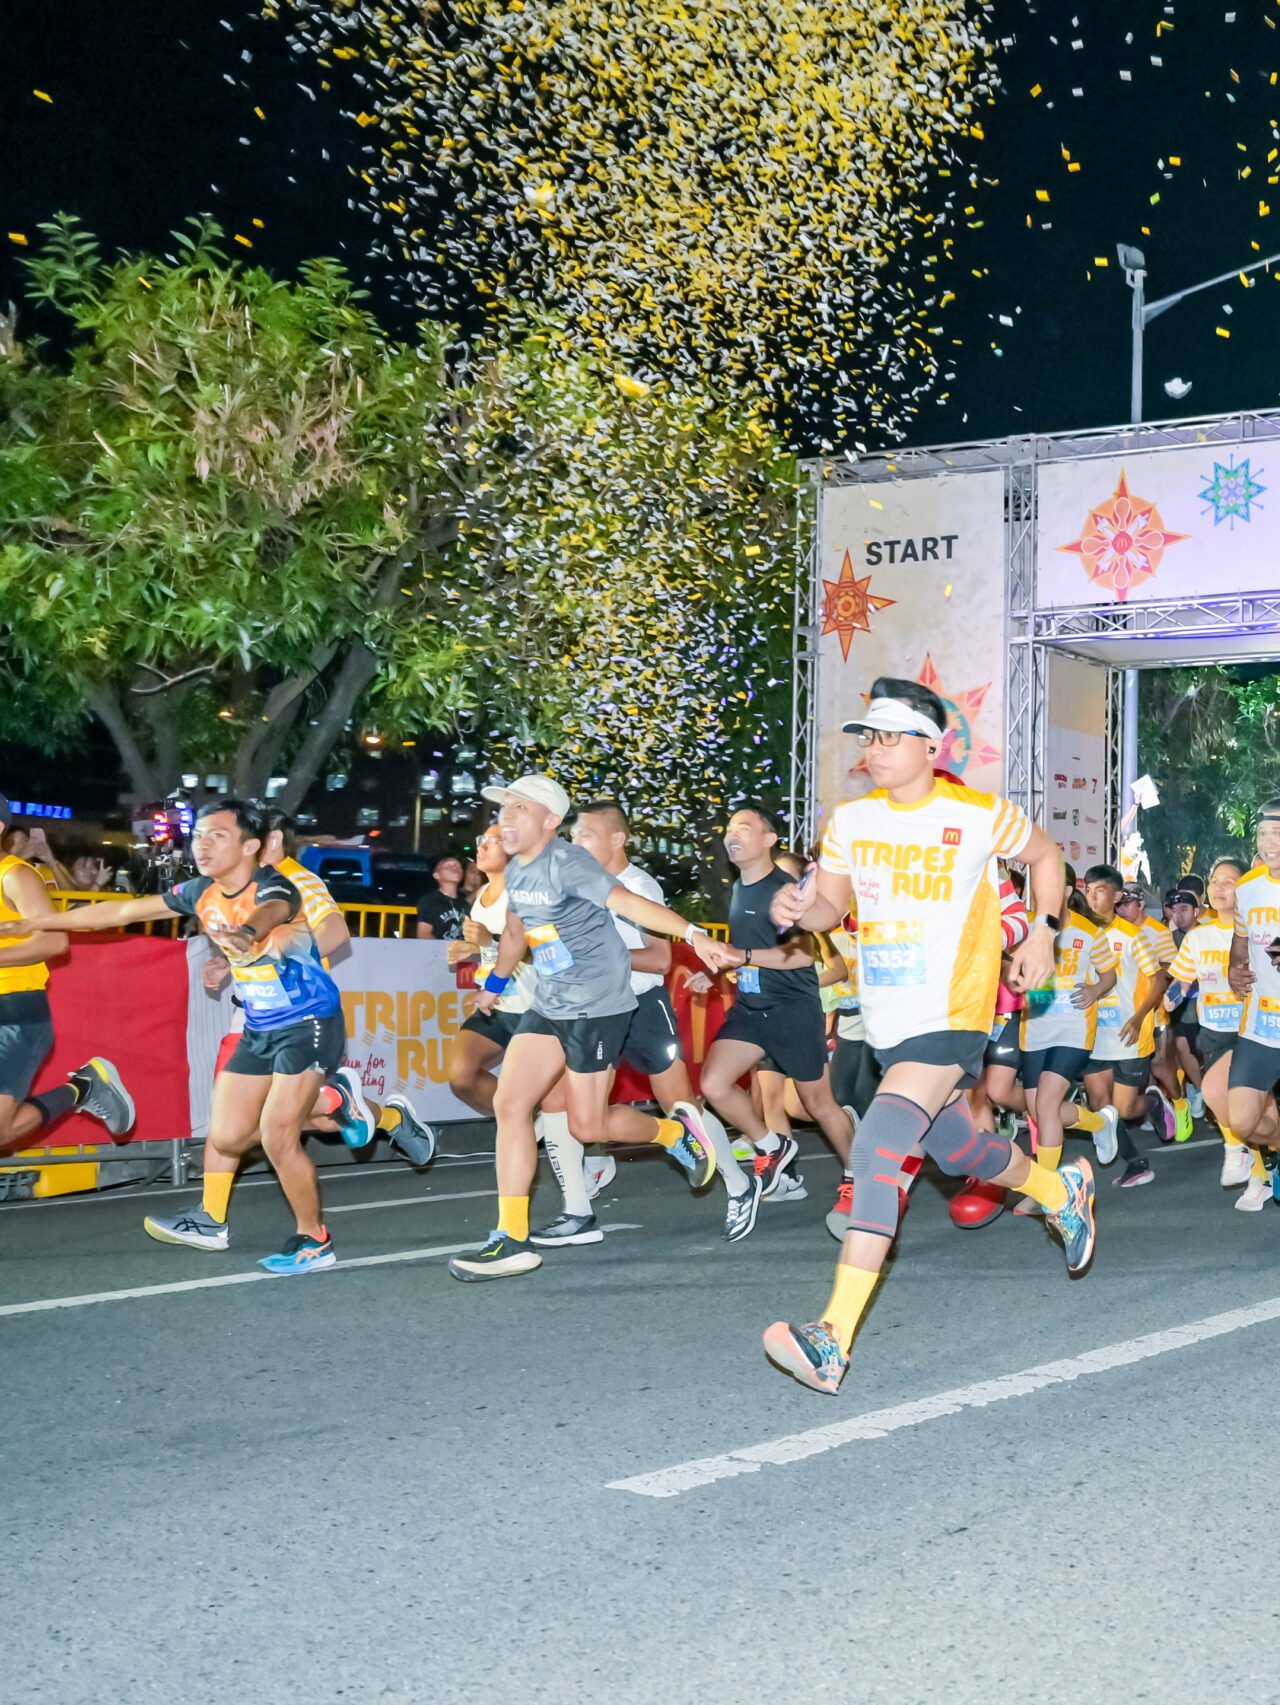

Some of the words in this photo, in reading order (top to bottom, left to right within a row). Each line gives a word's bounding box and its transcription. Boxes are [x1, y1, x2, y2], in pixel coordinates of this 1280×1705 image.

[865, 535, 959, 566] START
[851, 839, 958, 874] STRIPES
[892, 871, 954, 902] RUN
[340, 990, 477, 1046] TRIPE
[1208, 1007, 1239, 1020] 15776
[366, 1053, 386, 1074] for
[395, 1038, 451, 1092] RU
[361, 1071, 386, 1096] ding
